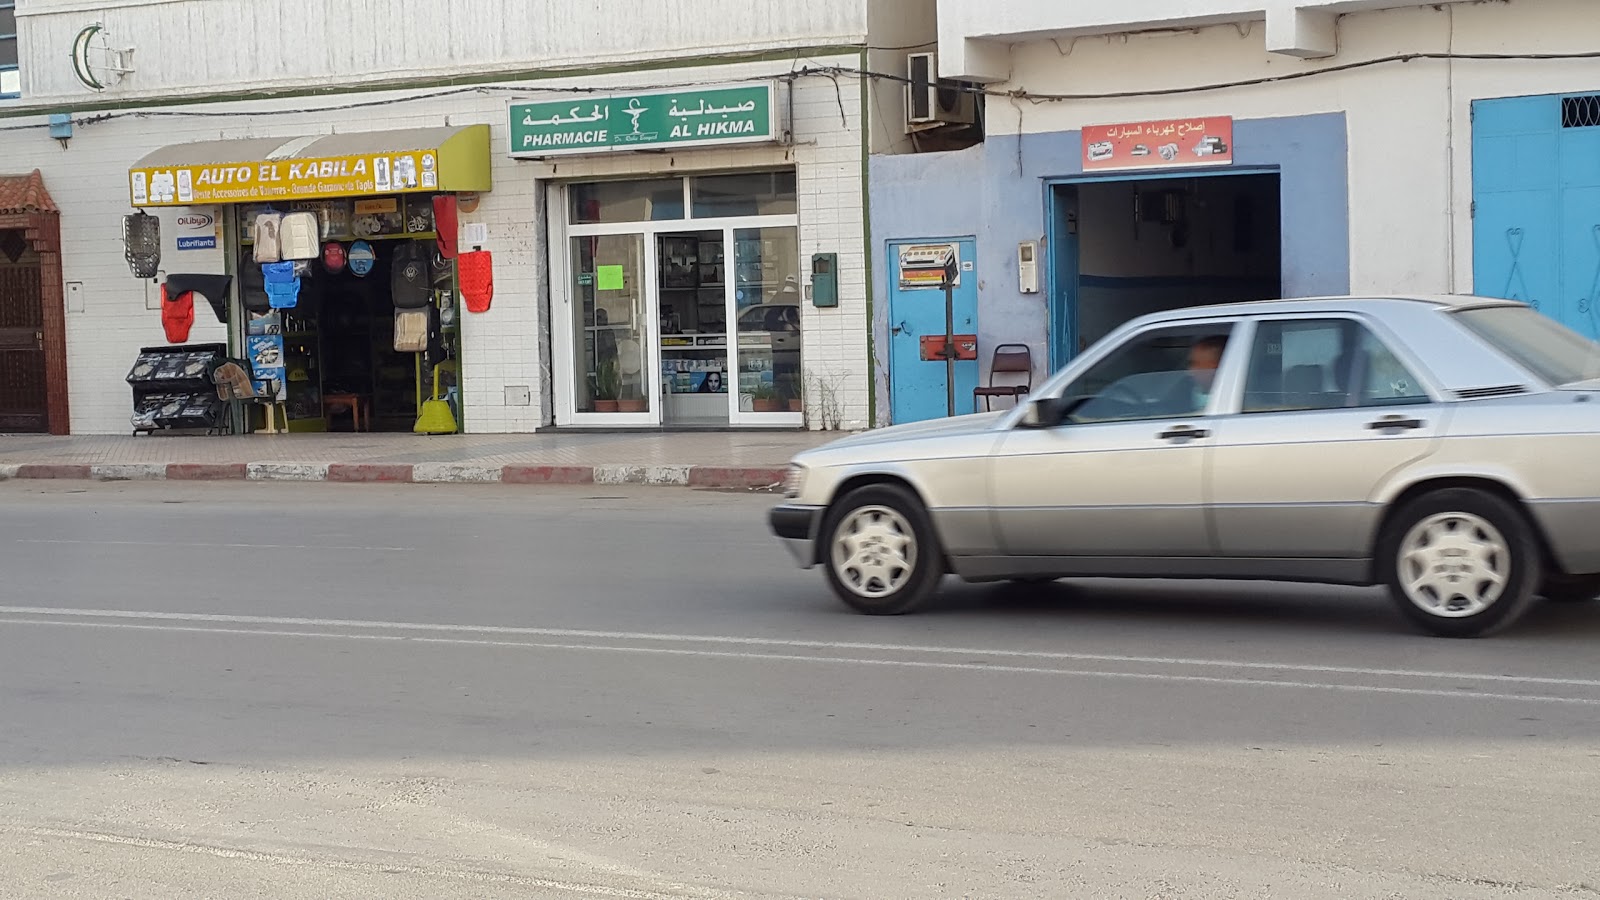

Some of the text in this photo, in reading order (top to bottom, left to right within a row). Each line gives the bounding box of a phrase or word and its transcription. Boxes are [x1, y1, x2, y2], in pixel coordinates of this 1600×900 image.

[522, 98, 756, 126] صيدلية الحكمة
[523, 130, 608, 147] PHARMACIE
[669, 125, 692, 138] AL
[696, 119, 755, 136] HIKMA
[1106, 121, 1206, 139] إصلاح كهرباء السيارات
[196, 158, 367, 185] AUTO EL KABILA
[212, 186, 249, 198] Accessoires
[249, 186, 258, 196] de
[345, 180, 354, 190] de
[355, 179, 374, 192] Tapis
[178, 239, 214, 248] Lubrifiants
